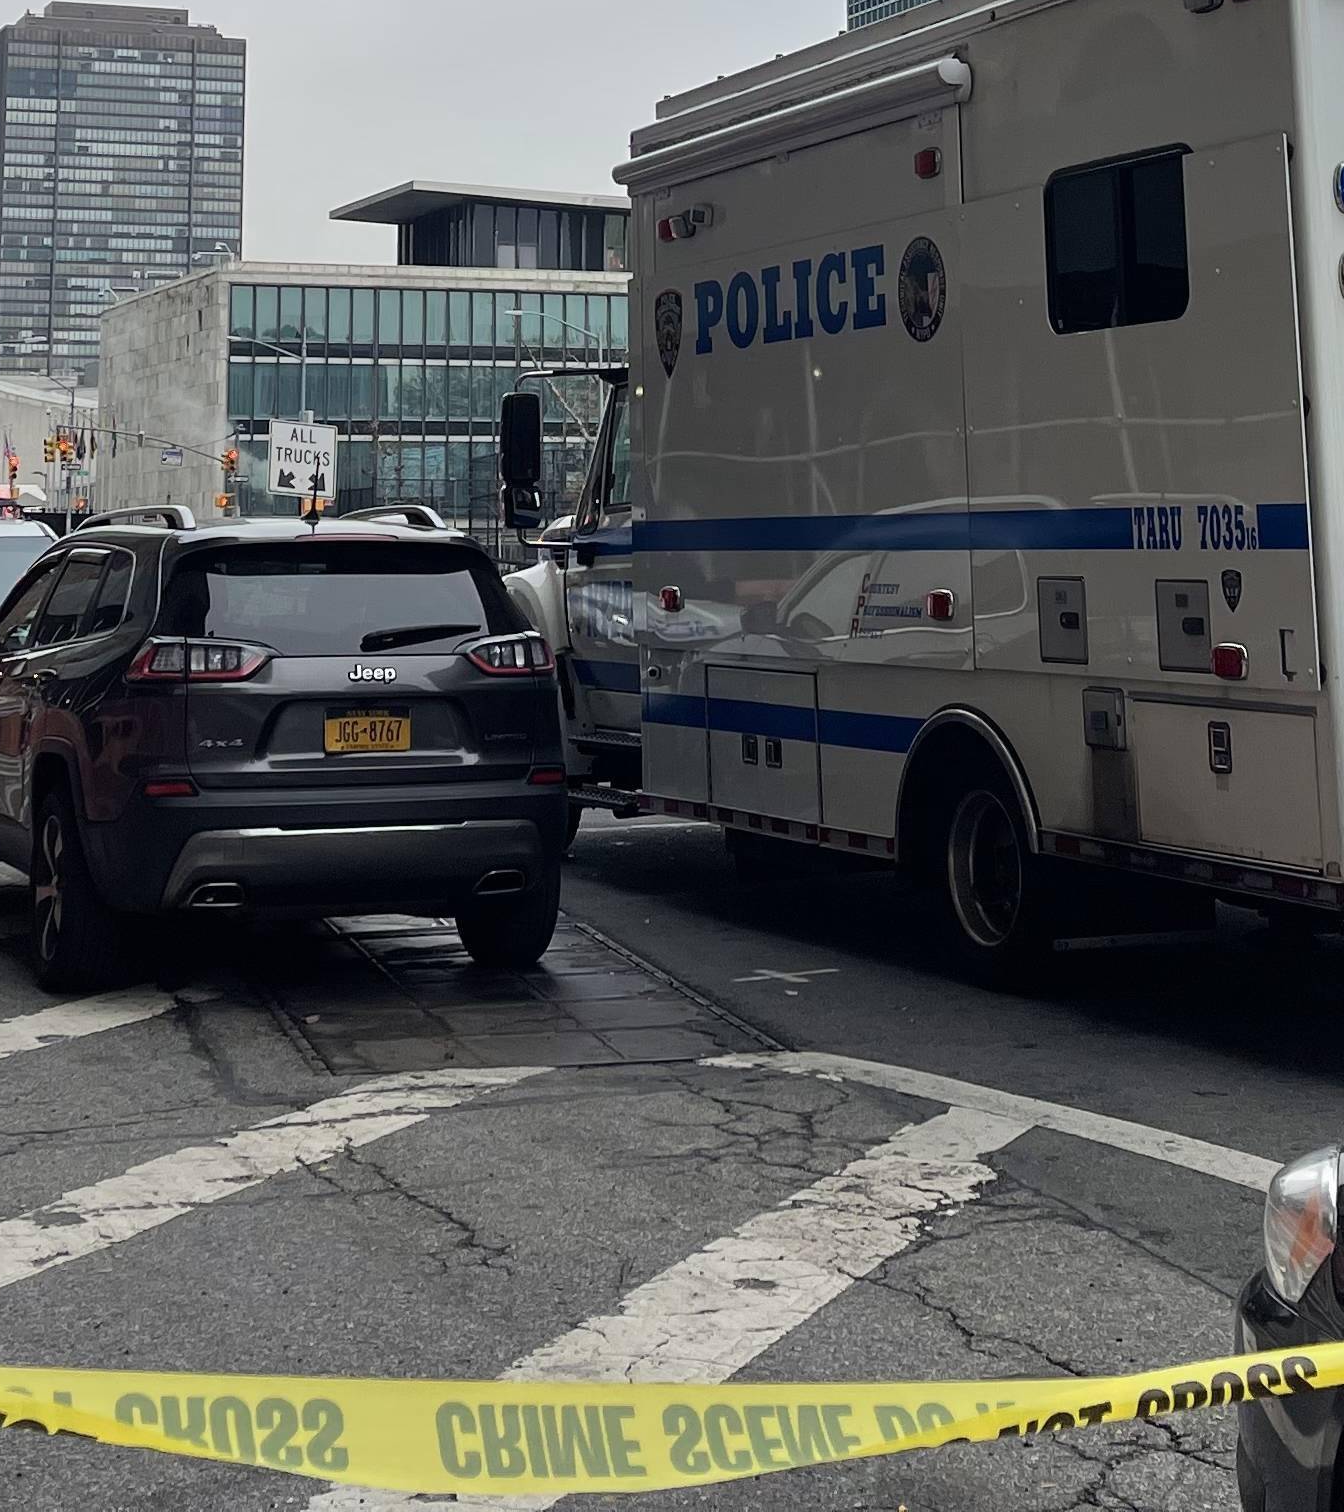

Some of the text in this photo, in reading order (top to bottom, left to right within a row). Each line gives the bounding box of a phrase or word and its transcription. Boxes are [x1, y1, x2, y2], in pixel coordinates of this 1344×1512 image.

[694, 244, 887, 356] POLICE
[290, 427, 317, 444] ALL
[276, 446, 330, 467] TRUCKS
[1133, 506, 1183, 550] TARU
[348, 664, 398, 684] Jeep
